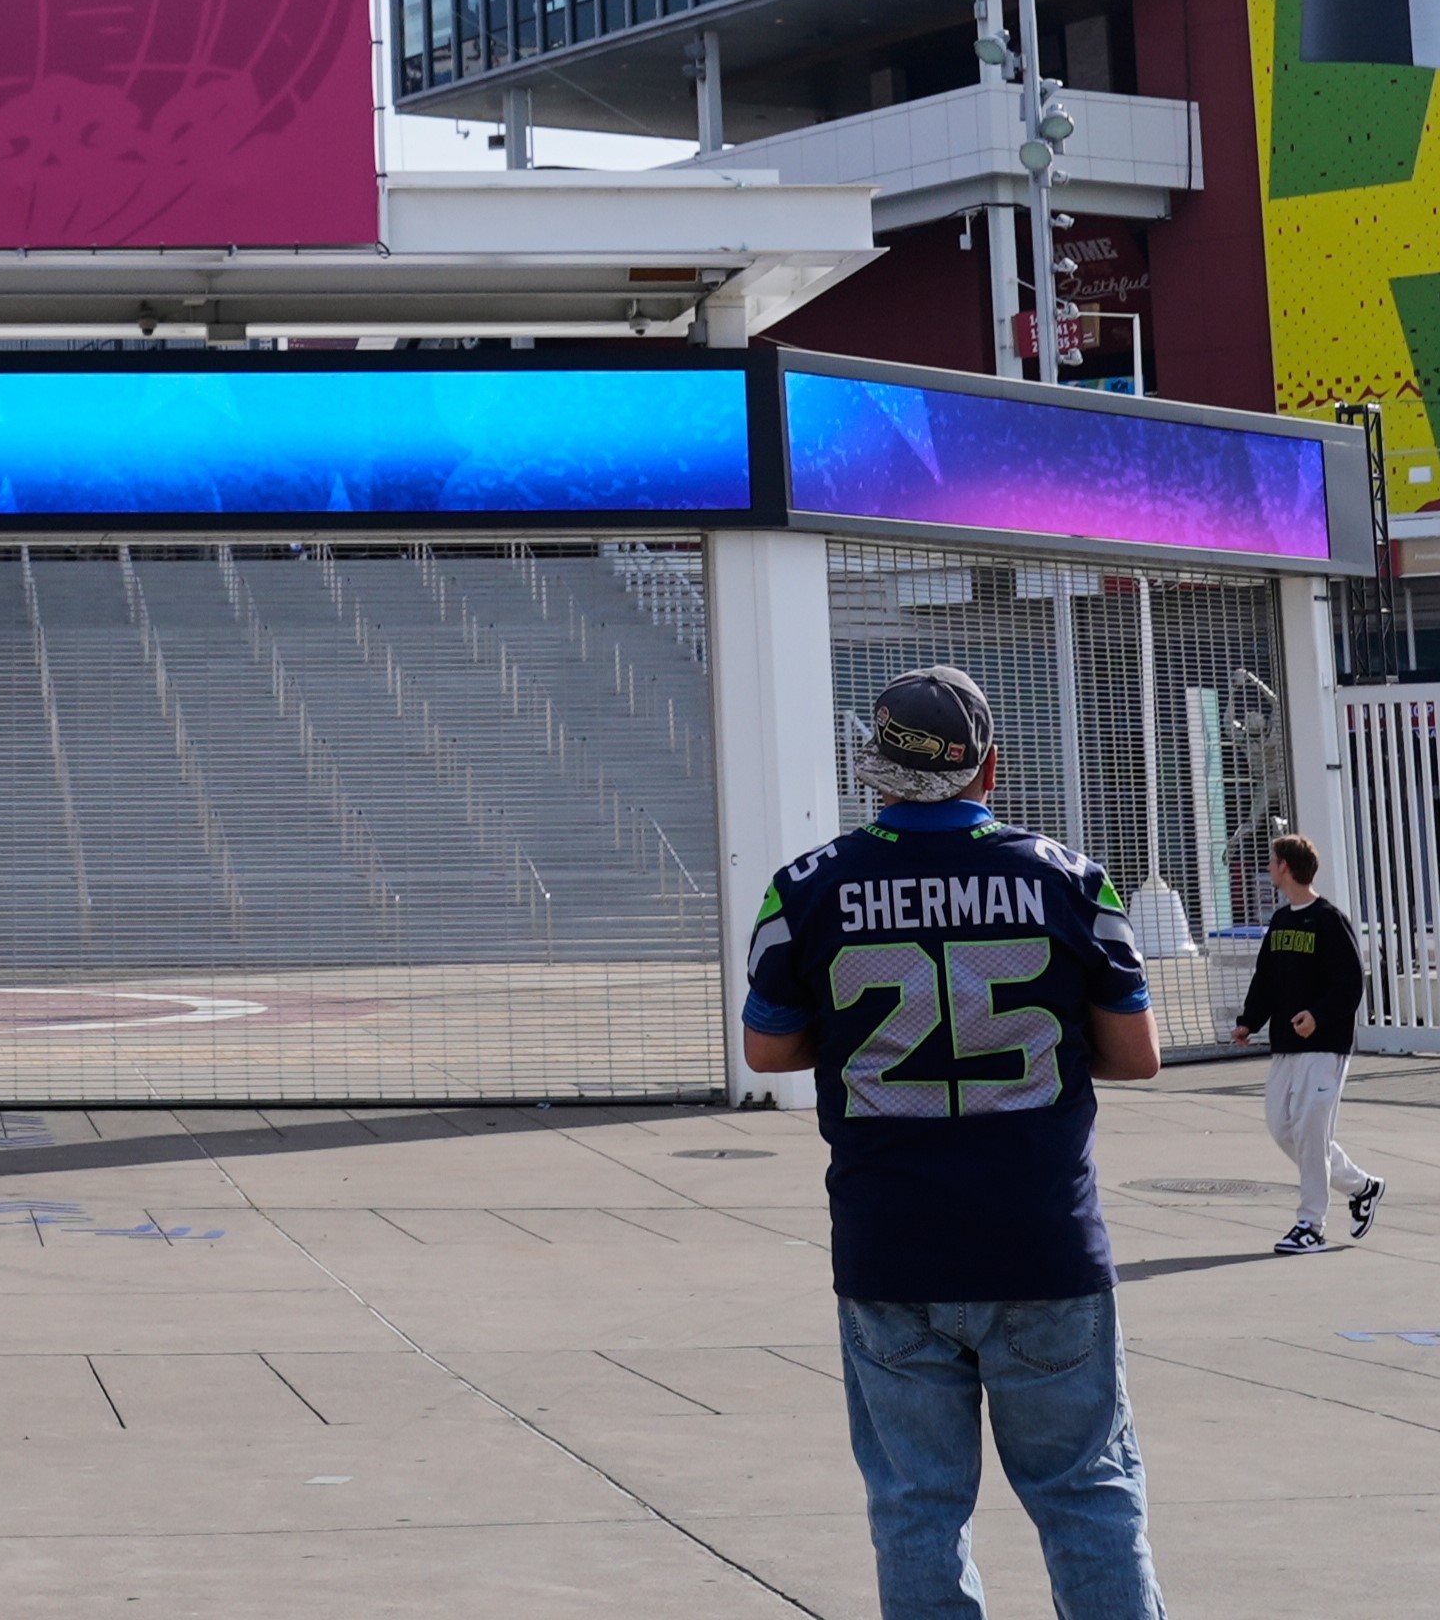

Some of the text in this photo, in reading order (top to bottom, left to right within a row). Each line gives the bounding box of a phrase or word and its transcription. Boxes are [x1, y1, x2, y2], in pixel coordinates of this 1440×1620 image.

[1059, 274, 1152, 302] Faithful
[838, 876, 1046, 932] SHERMAN
[829, 936, 1063, 1118] 25
